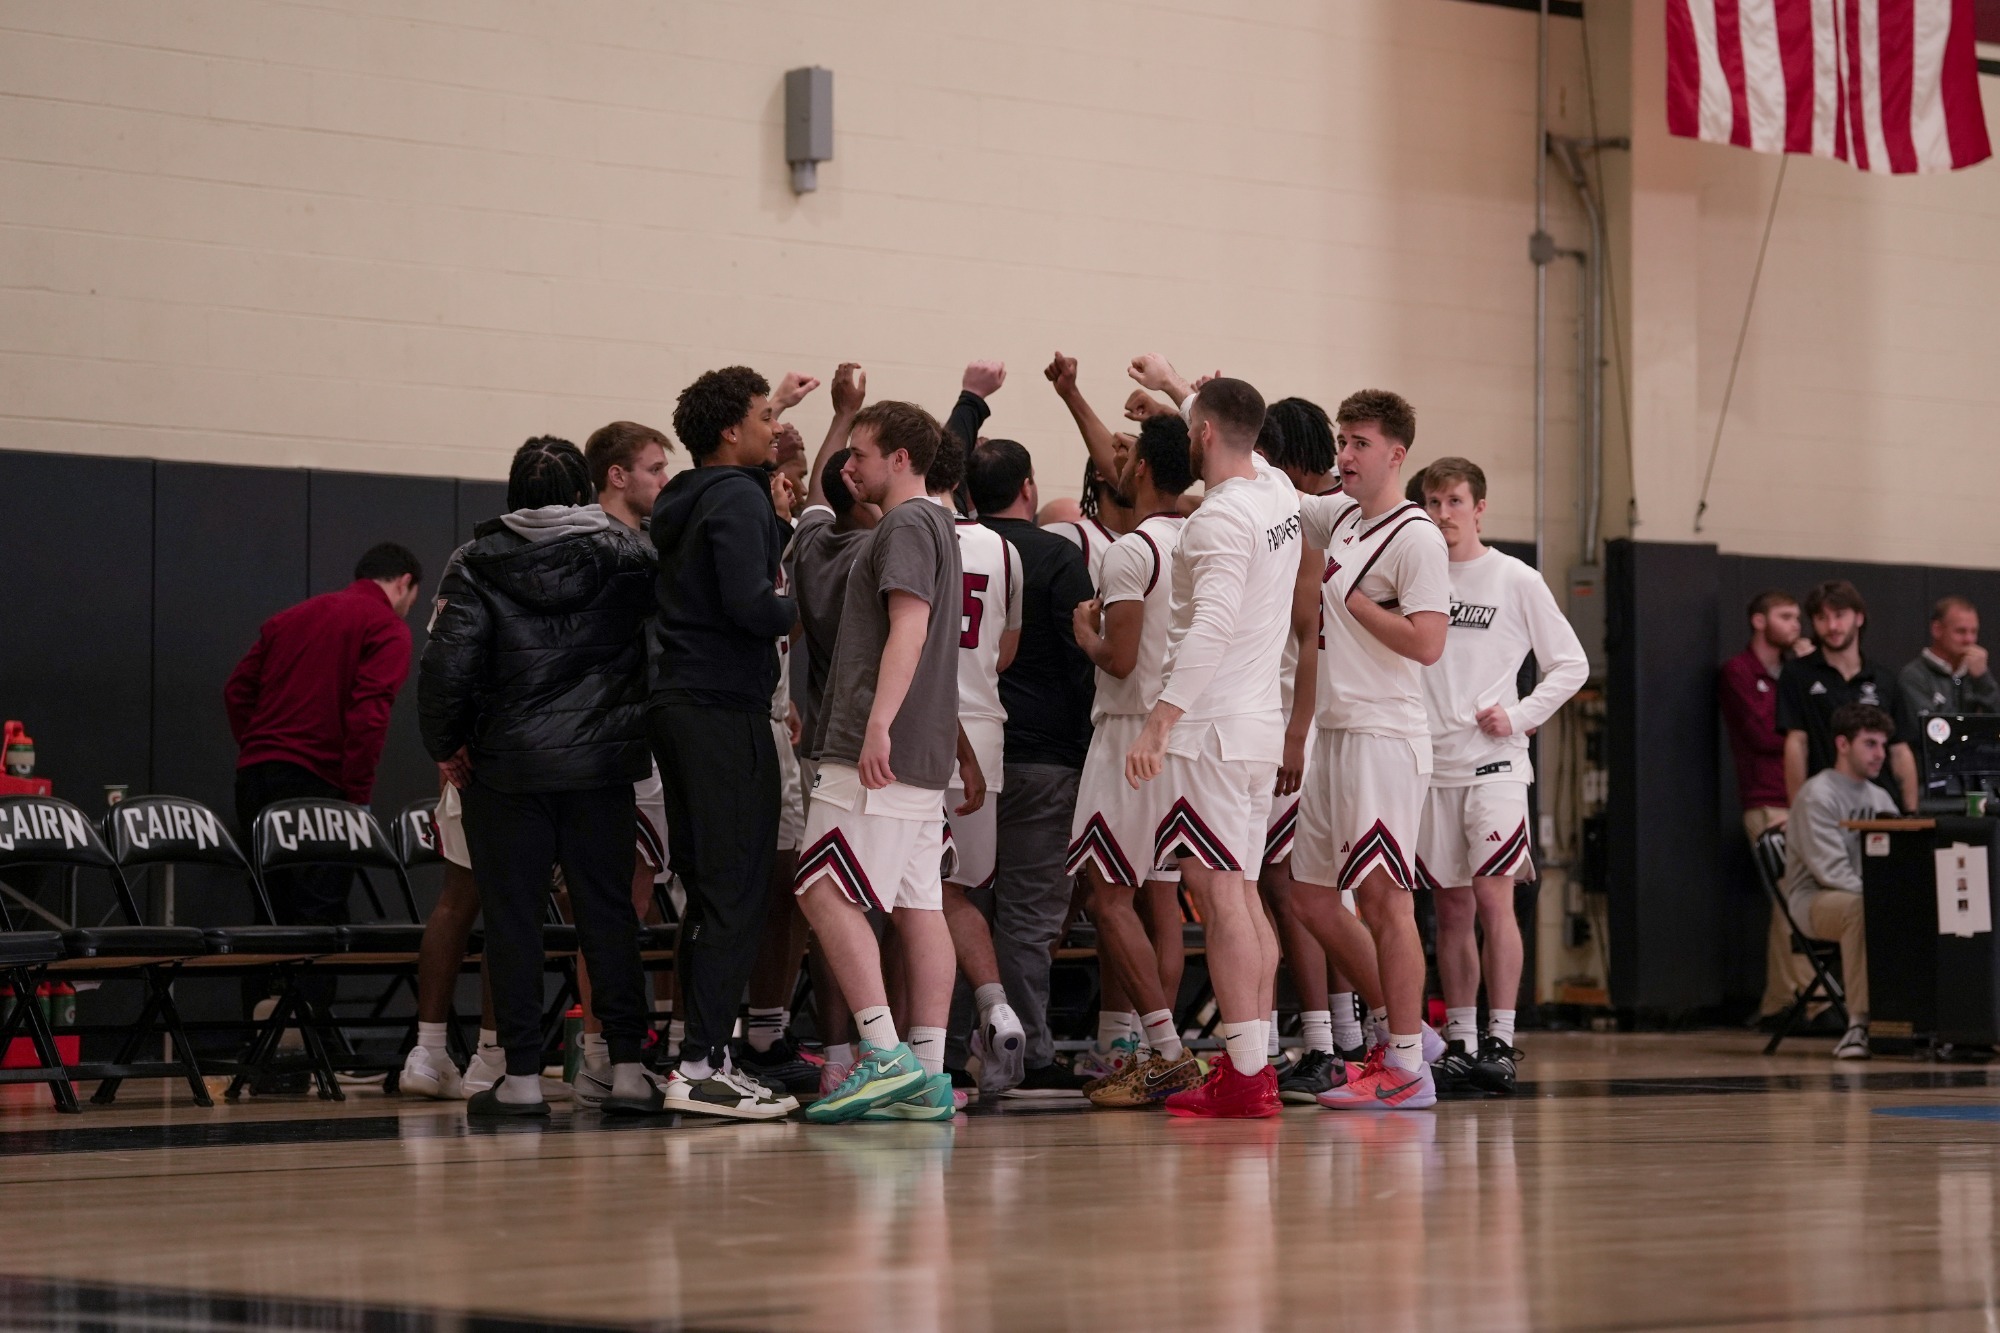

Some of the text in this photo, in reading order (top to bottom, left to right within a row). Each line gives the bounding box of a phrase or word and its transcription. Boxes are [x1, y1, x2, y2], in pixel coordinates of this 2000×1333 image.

[959, 572, 989, 649] 5
[1448, 602, 1495, 625] CAIRN
[122, 805, 219, 850] CAIRN
[271, 808, 372, 851] CAIRN
